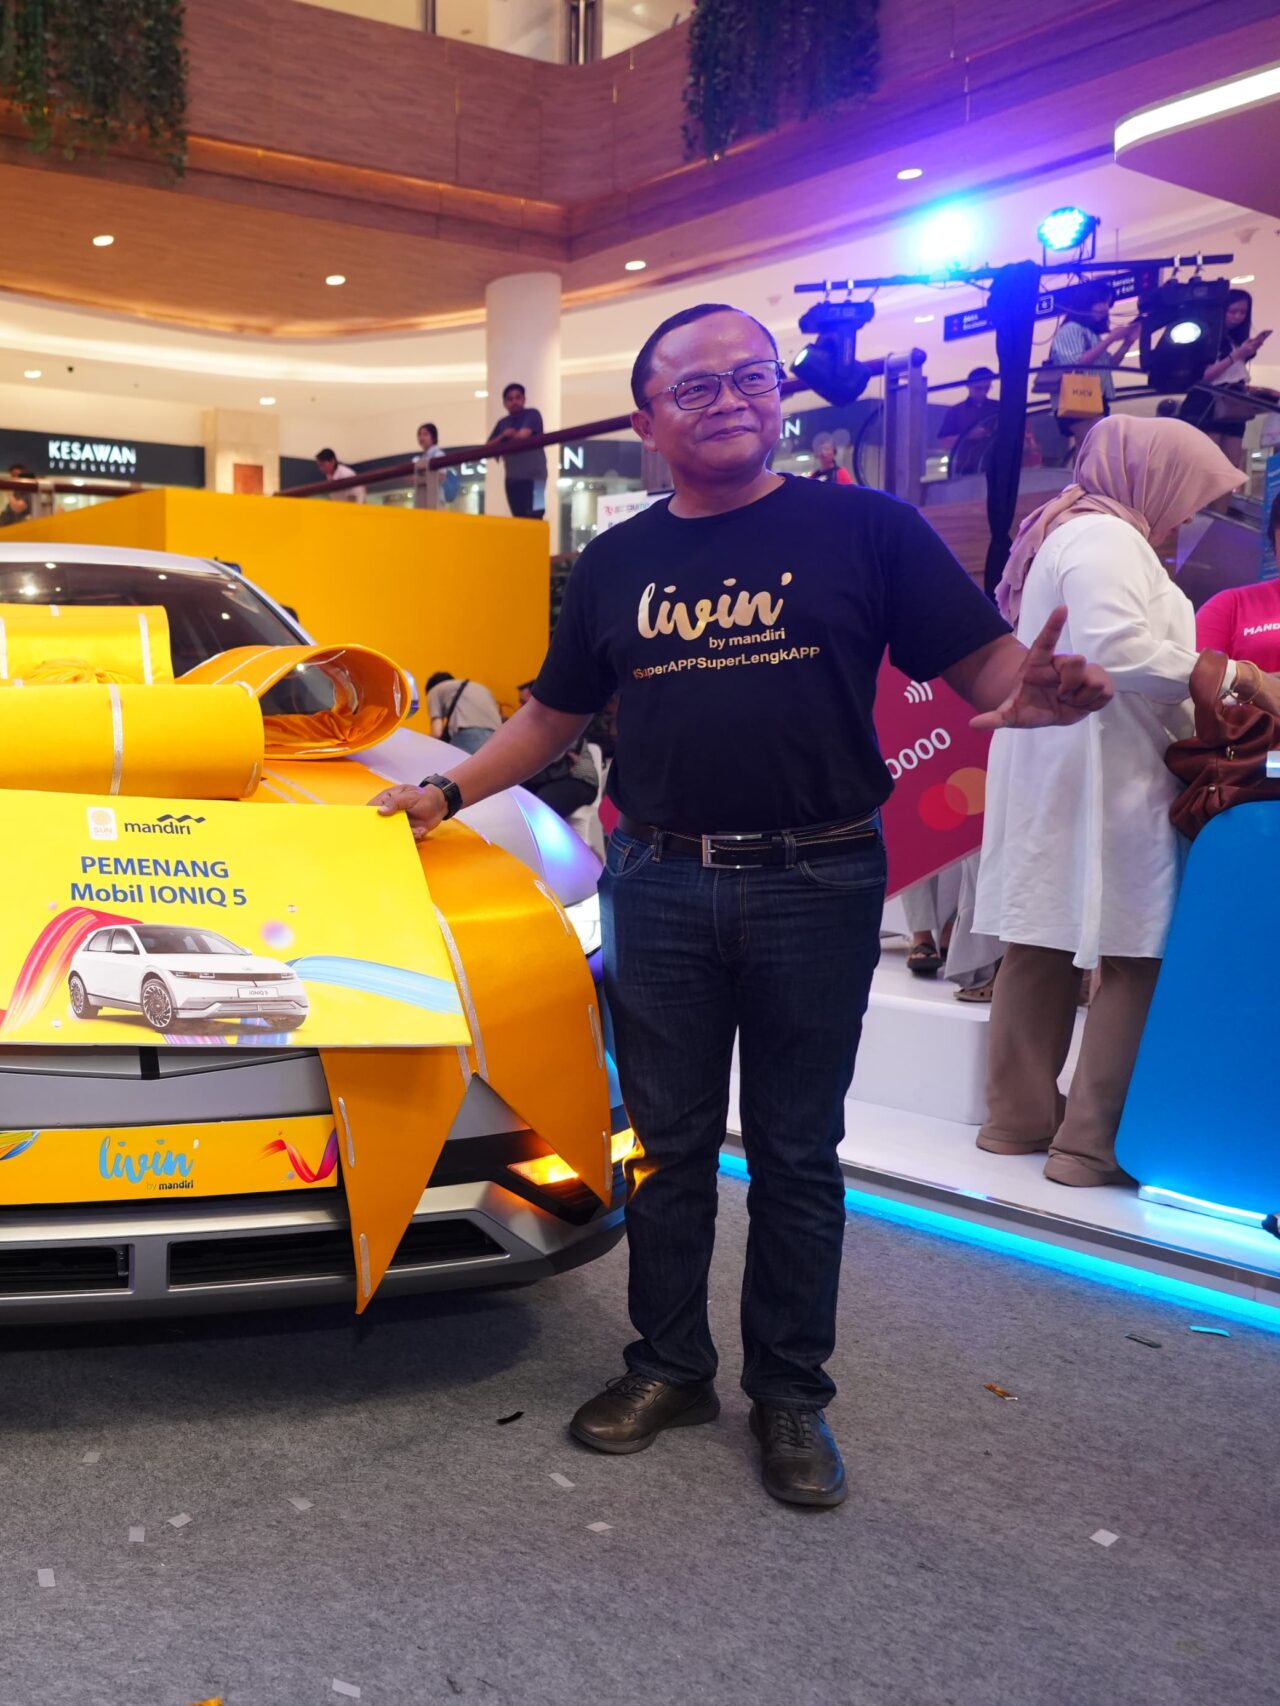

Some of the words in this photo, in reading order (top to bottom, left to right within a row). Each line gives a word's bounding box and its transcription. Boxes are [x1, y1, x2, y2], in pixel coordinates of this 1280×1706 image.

[48, 440, 136, 465] KESAWAN
[709, 637, 726, 650] by
[729, 628, 786, 646] mandiri
[124, 822, 191, 835] mandiri
[81, 856, 229, 879] PEMENANG
[70, 883, 144, 904] Mobil
[150, 885, 228, 908] IONIQ
[233, 889, 247, 906] 5
[158, 1180, 194, 1191] mandiri
